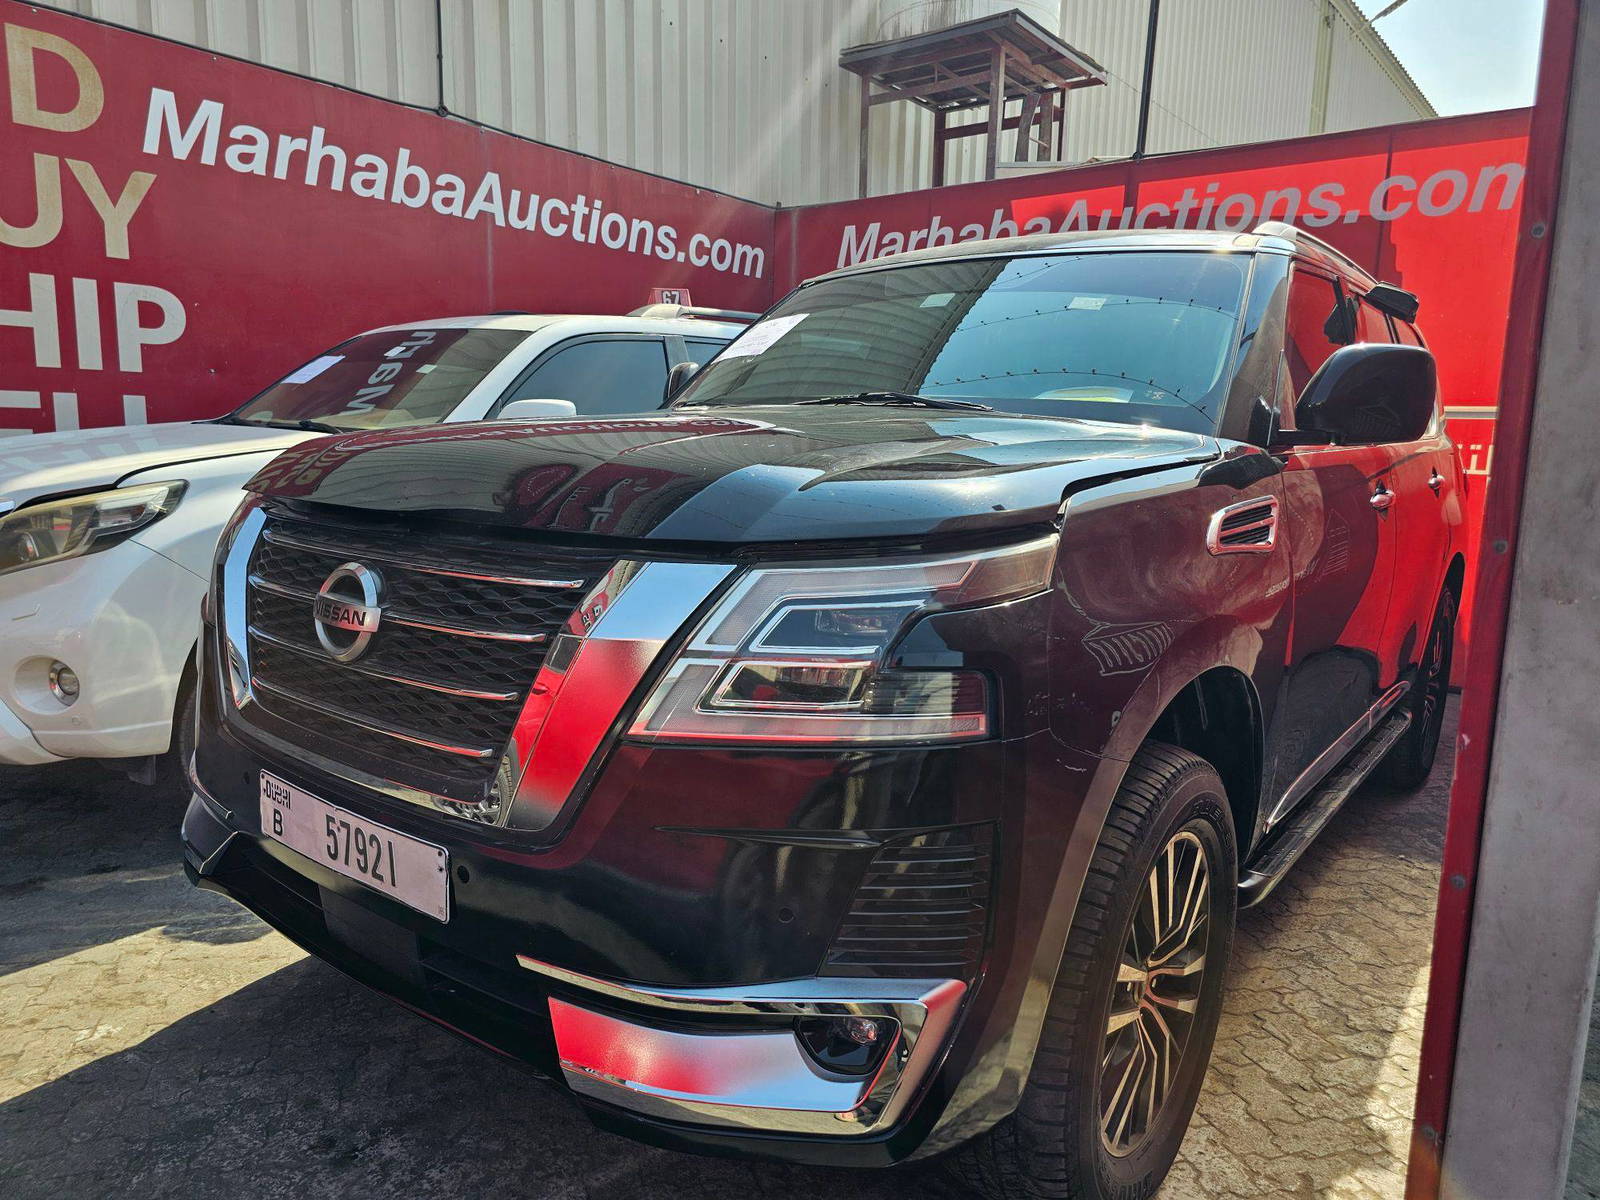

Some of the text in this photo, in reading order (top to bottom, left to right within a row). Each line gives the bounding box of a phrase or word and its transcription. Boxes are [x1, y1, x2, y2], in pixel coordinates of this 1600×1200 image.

[142, 87, 765, 279] MarhabaAuctions.com
[315, 599, 367, 627] NISSAN
[273, 808, 283, 837] B
[325, 814, 397, 888] 57921
